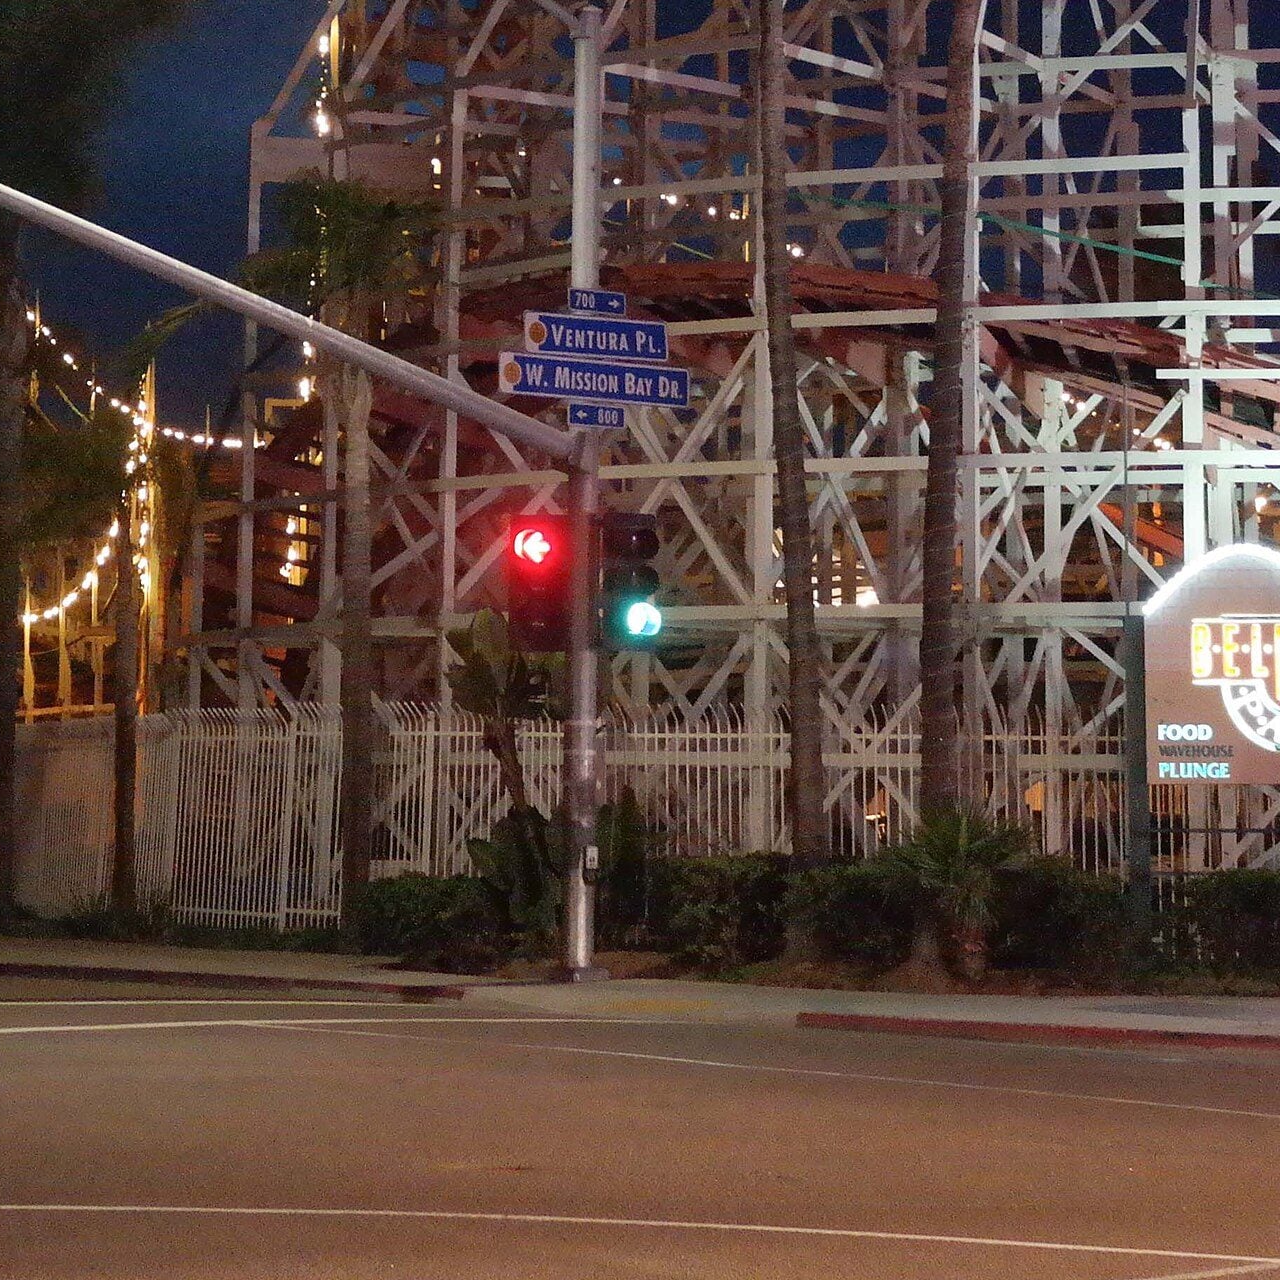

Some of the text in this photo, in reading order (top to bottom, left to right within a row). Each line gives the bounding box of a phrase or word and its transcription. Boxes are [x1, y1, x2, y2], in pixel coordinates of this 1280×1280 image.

[575, 292, 596, 308] 700
[551, 323, 661, 354] VENTURA PL.
[525, 363, 683, 399] W. MISSION BAY DR.
[597, 409, 618, 425] 800
[1157, 724, 1213, 741] FOOD
[1158, 744, 1235, 757] WAVEHOUSE
[1158, 762, 1231, 779] PLUNGE
